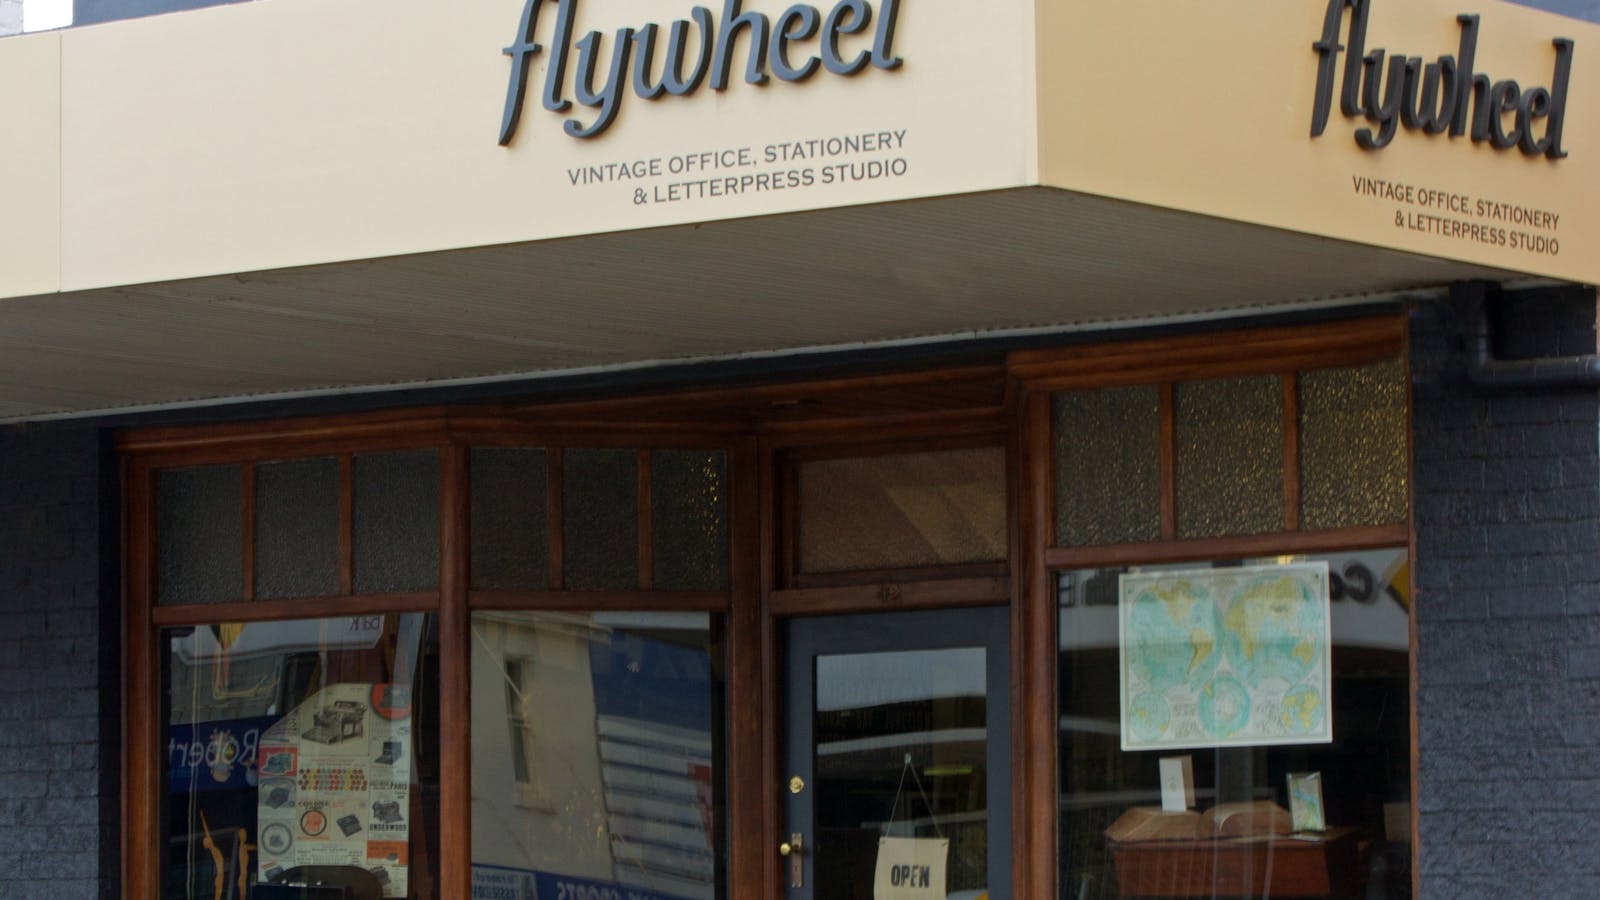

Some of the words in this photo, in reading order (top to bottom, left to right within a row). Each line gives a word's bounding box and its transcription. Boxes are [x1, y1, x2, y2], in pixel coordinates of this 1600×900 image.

[498, 0, 904, 147] flywheel
[1310, 0, 1575, 159] flywheel
[568, 158, 664, 186] VINTAGE
[667, 147, 758, 175] OFFICE,
[763, 129, 908, 162] STATIONERY
[633, 186, 648, 206] &
[653, 165, 815, 204] LETTERPRESS
[821, 157, 908, 184] STUDIO
[1352, 174, 1414, 204] VINTAGE
[1417, 187, 1473, 217] OFFICE,
[1476, 198, 1560, 231] STATIONERY
[1394, 209, 1405, 228] &
[1407, 212, 1507, 247] LETTERPRESS
[1509, 236, 1560, 256] STUDIO
[890, 864, 930, 888] OPEN
